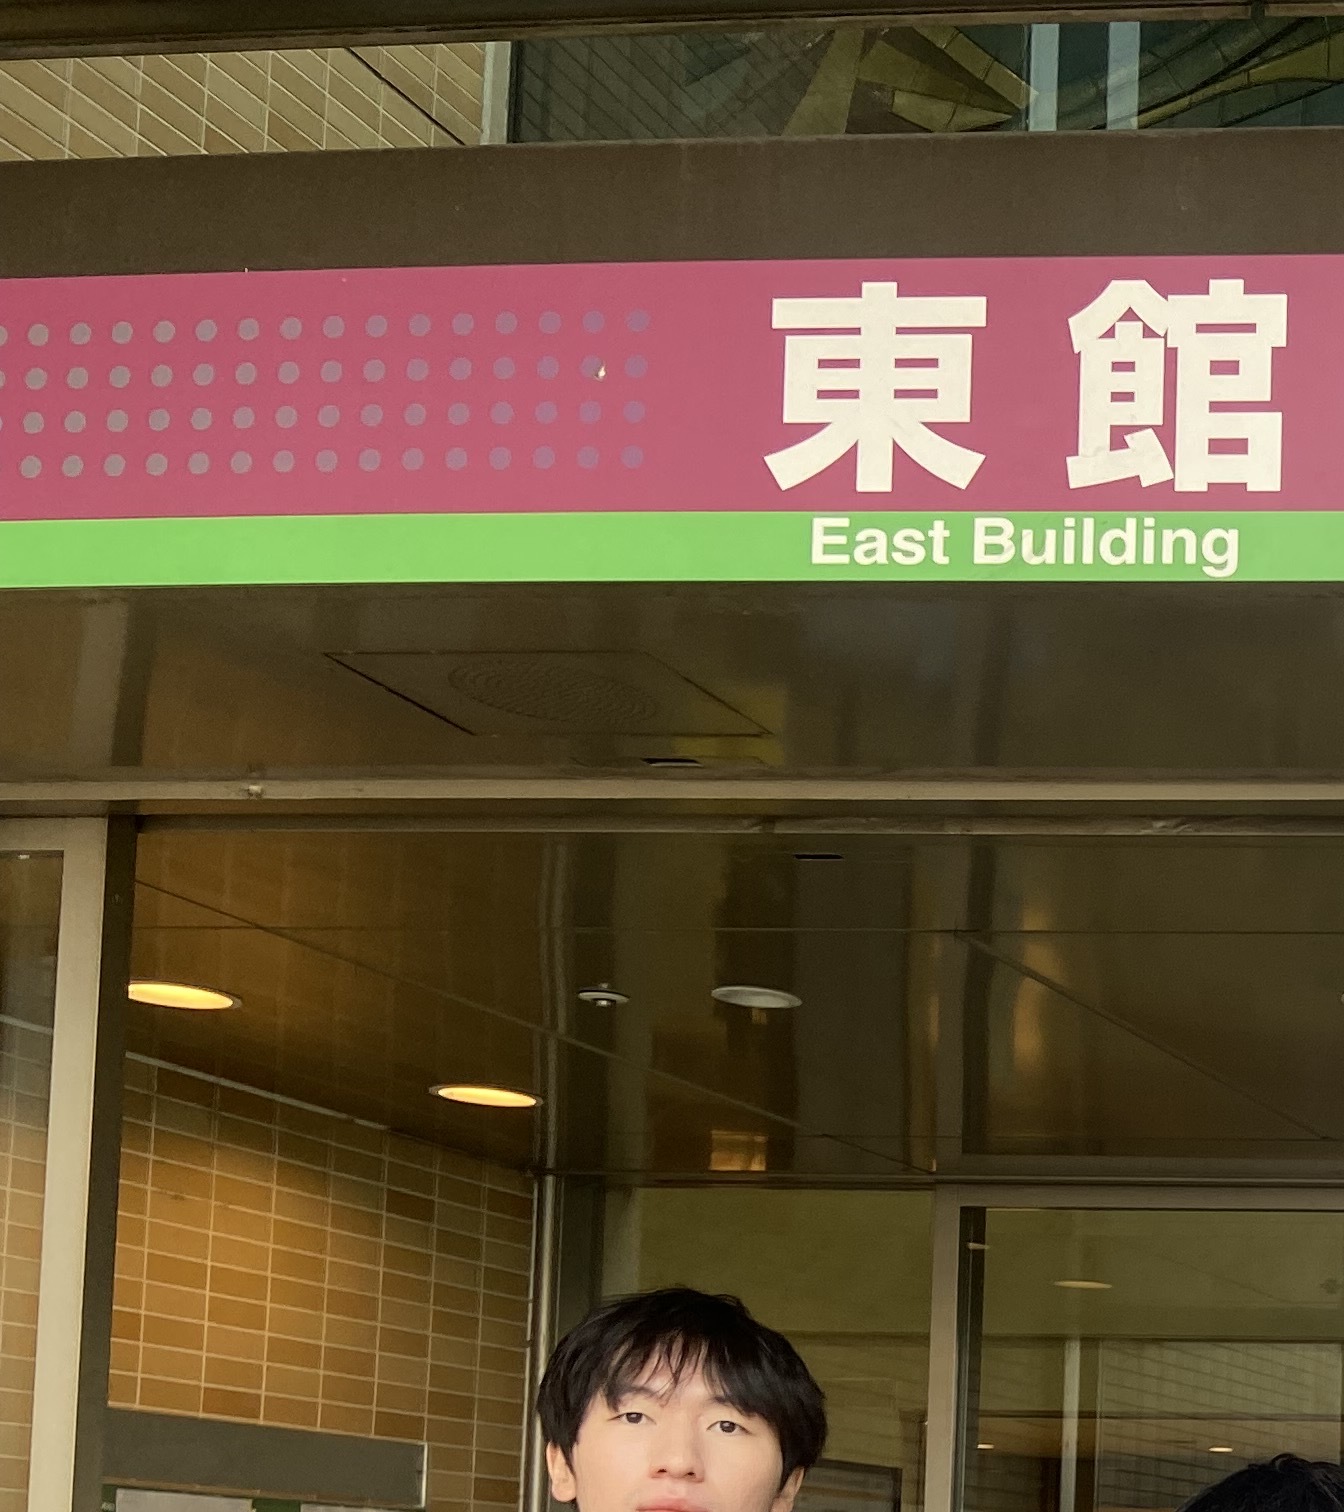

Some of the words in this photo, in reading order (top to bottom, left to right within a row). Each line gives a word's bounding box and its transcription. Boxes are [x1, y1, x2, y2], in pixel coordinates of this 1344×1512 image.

[763, 278, 1288, 492] 東館
[810, 516, 950, 565] East
[973, 516, 1239, 578] Building
